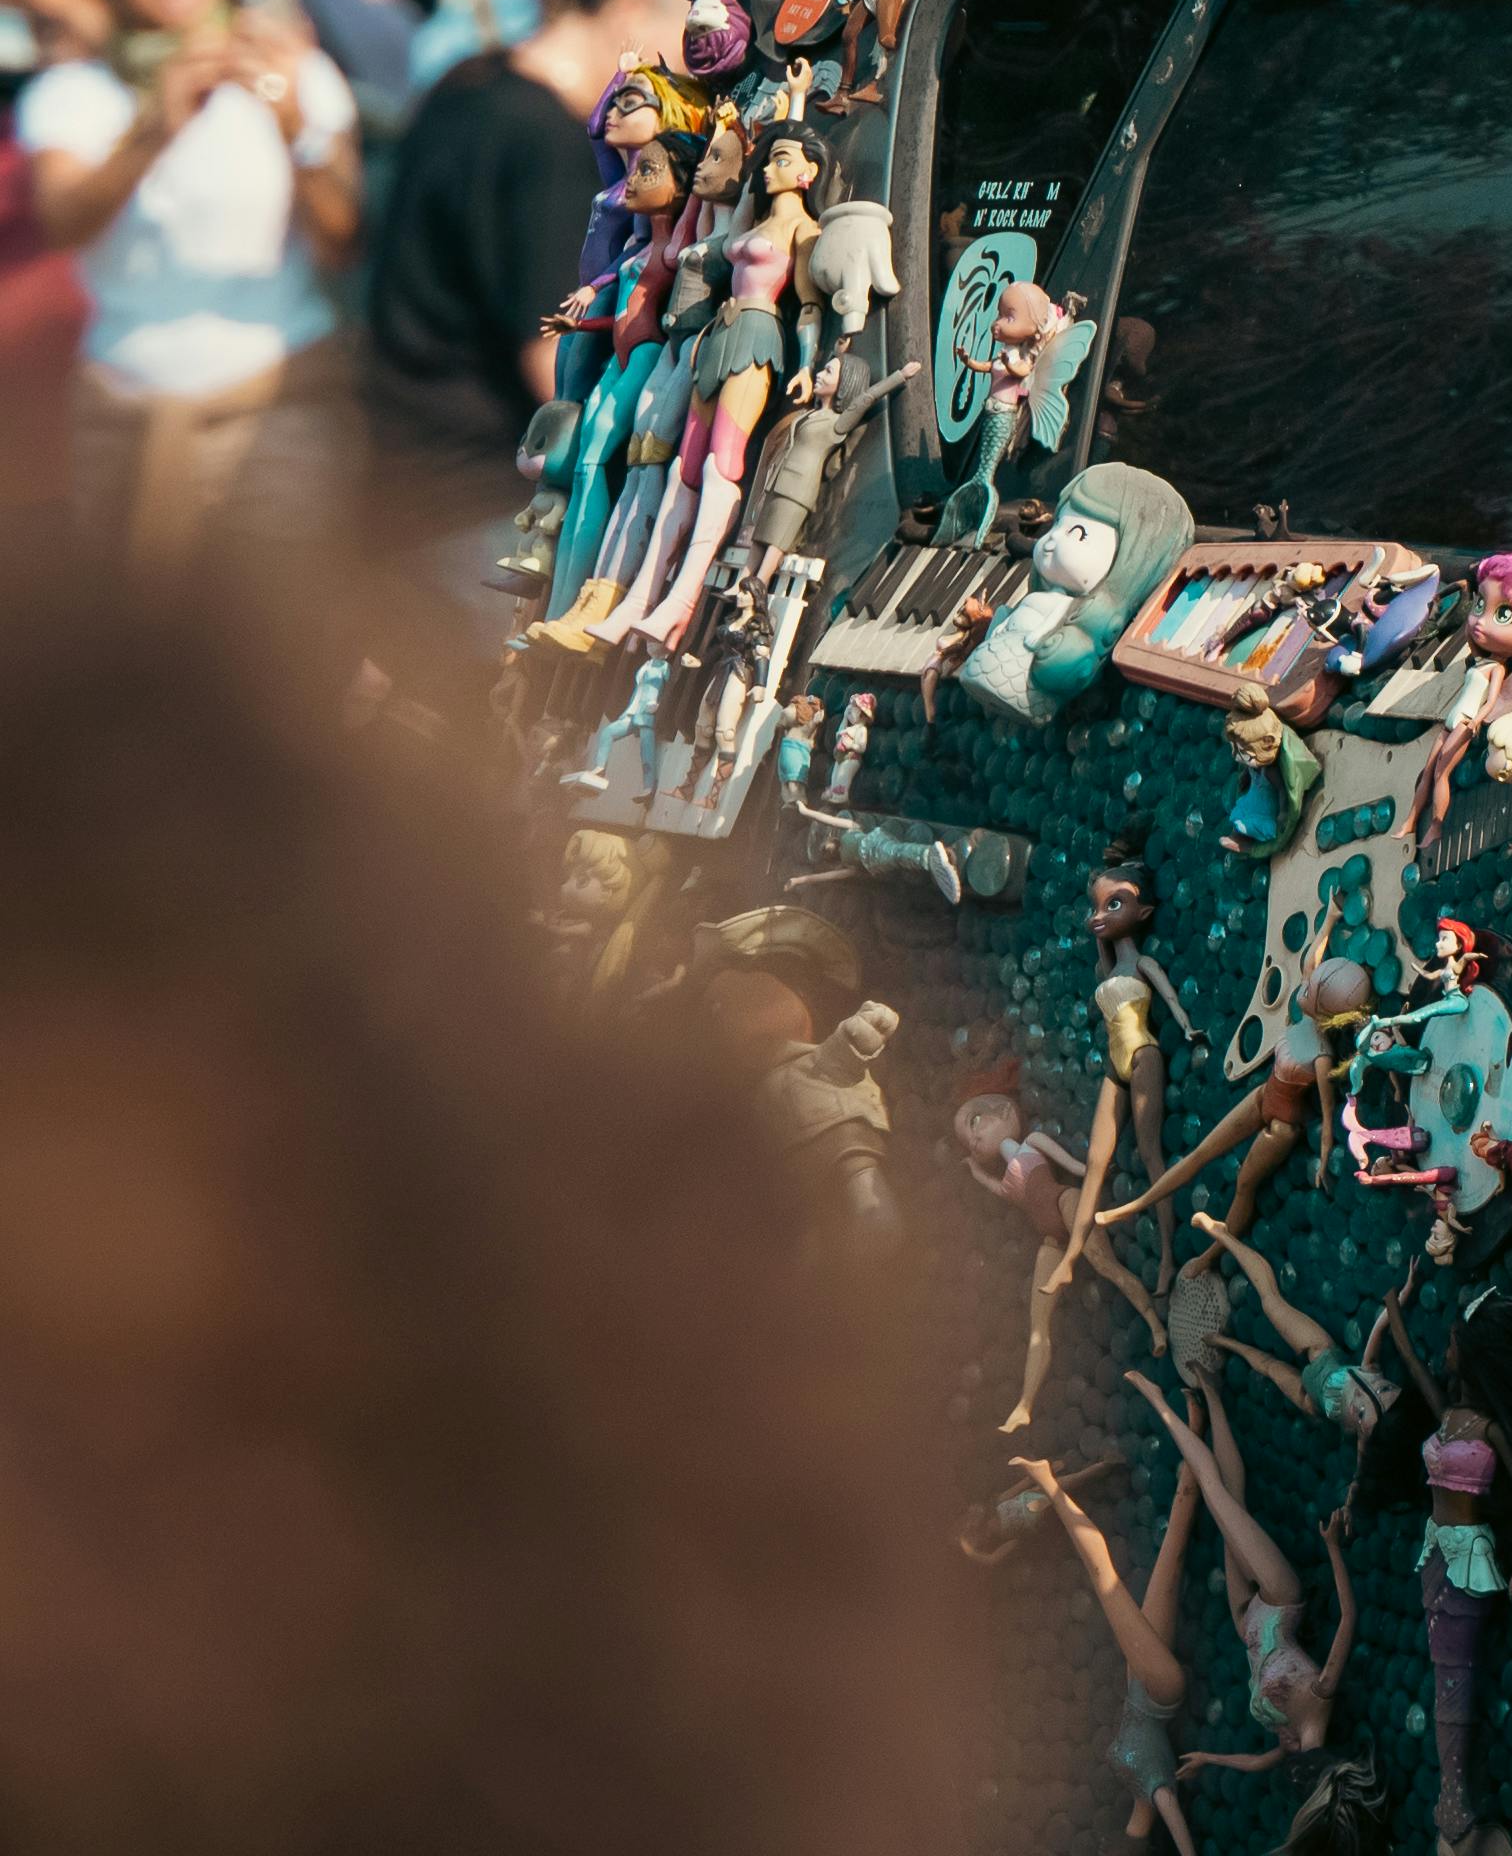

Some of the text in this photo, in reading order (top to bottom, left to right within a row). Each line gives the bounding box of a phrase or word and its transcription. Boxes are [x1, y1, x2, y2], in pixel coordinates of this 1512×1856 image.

[978, 180, 1012, 200] GIRLZ
[988, 209, 1018, 227] ROCK
[1019, 209, 1052, 228] CAMP
